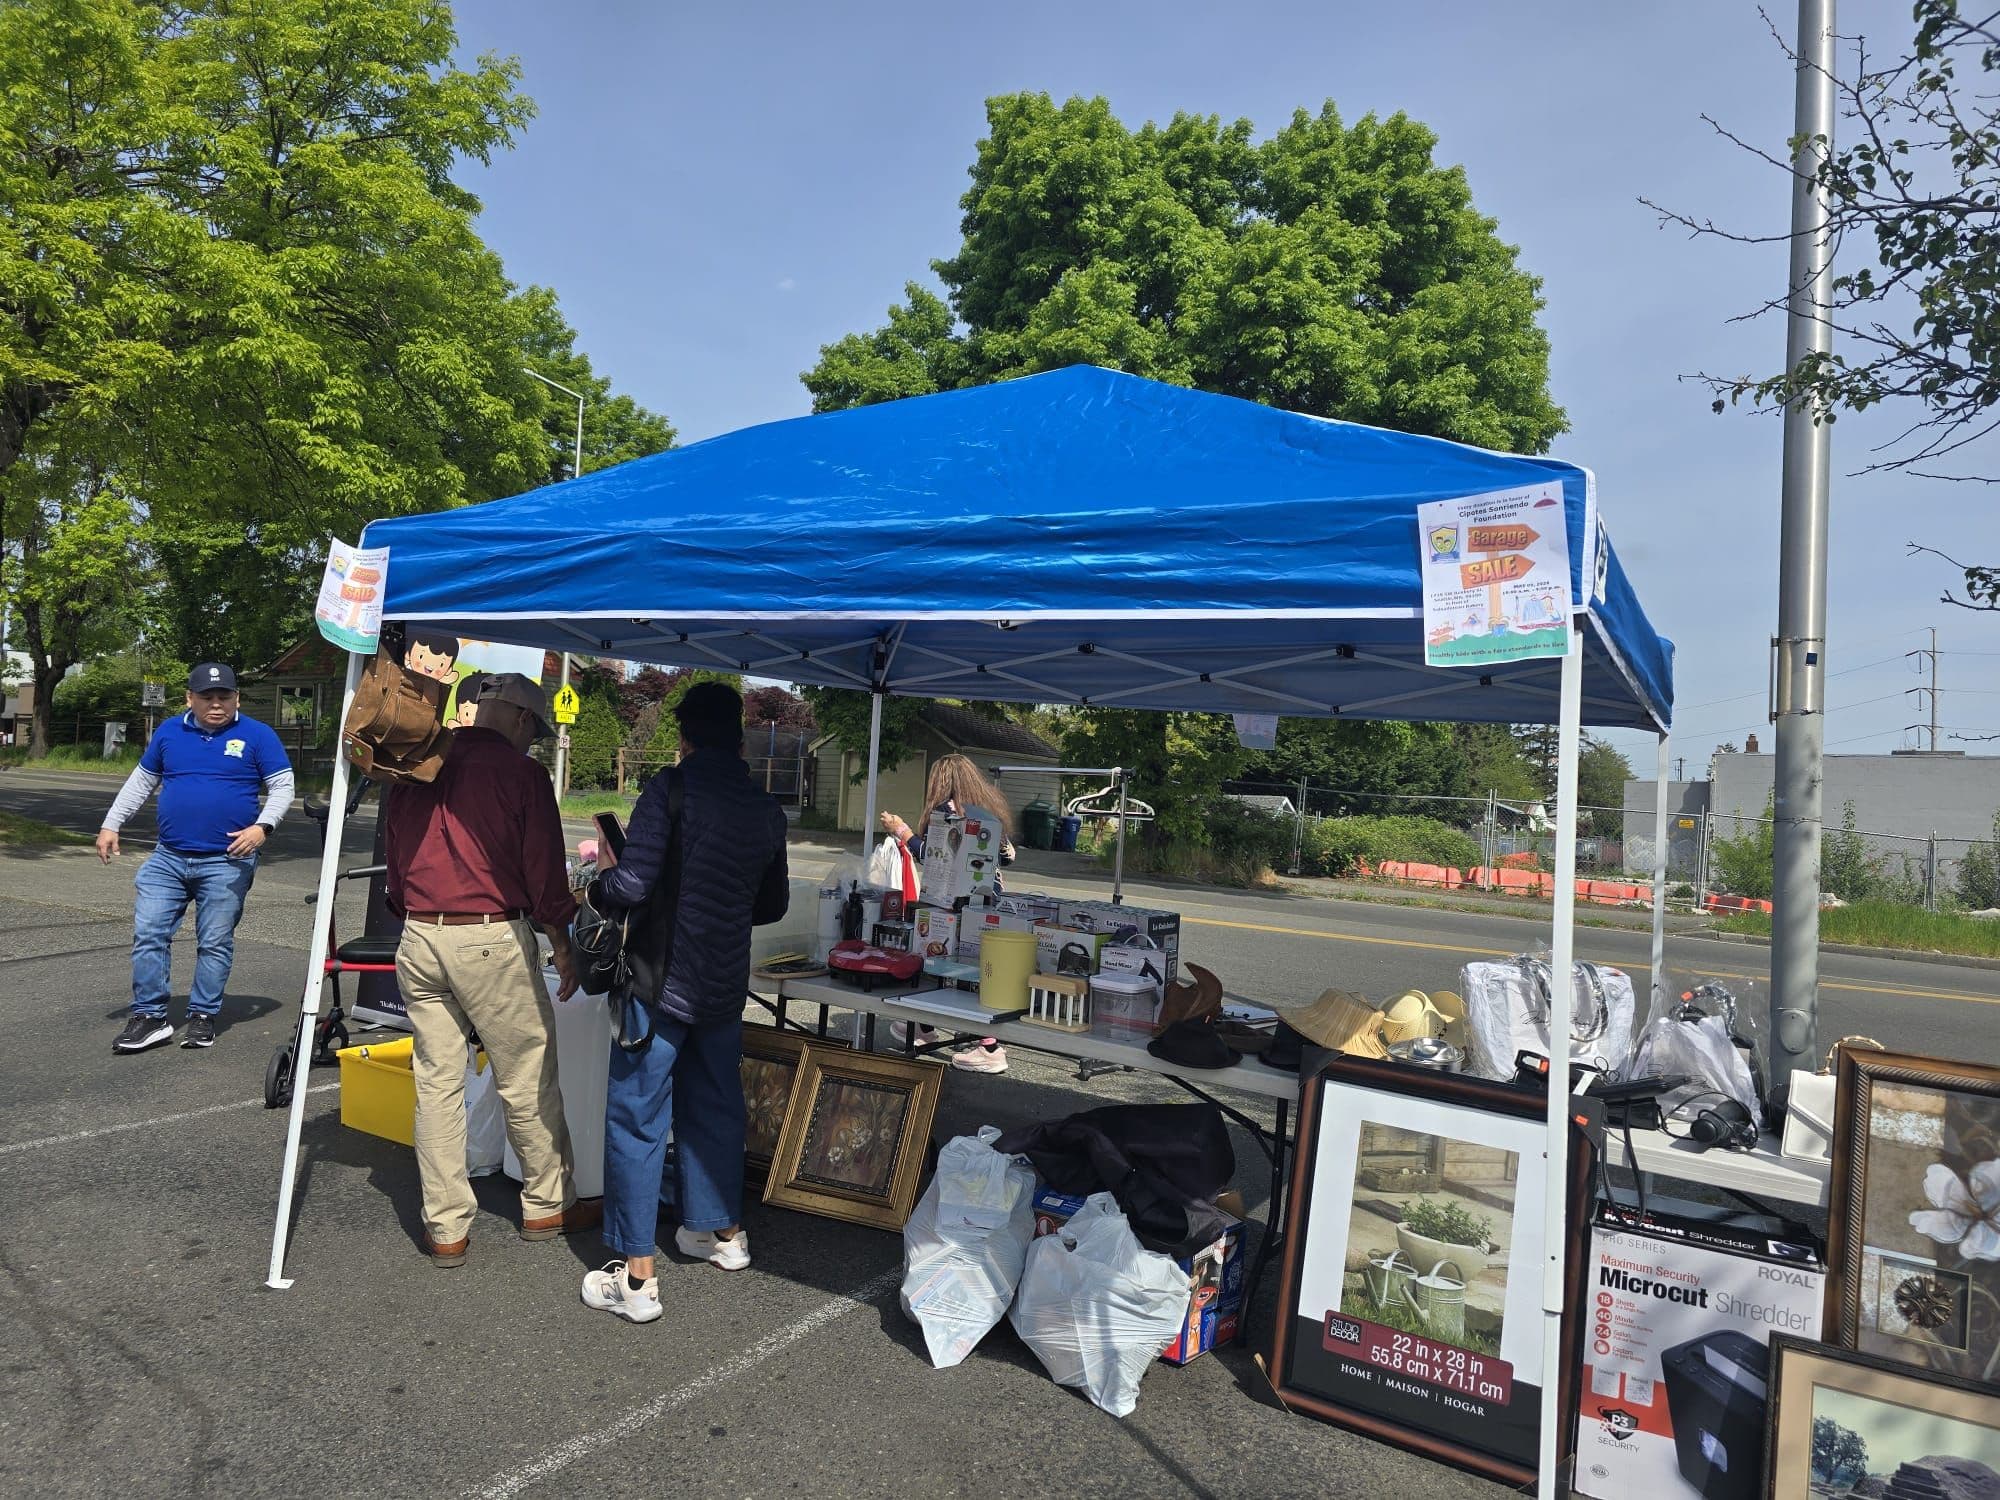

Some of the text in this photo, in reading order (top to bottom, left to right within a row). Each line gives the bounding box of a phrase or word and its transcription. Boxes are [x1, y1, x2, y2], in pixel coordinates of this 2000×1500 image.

[1459, 507, 1487, 518] Cipotes
[1474, 511, 1517, 523] Foundation
[1471, 529, 1528, 547] Garage
[1468, 556, 1519, 584] SALE
[345, 586, 374, 600] SALE
[1602, 1234, 1667, 1255] PRO SERIES
[1688, 1231, 1757, 1250] Shredder
[1601, 1253, 1700, 1286] Maximum Security
[1758, 1265, 1815, 1290] ROYAL
[1600, 1267, 1812, 1332] Microcut Shredder
[1600, 1295, 1610, 1304] 18
[1597, 1311, 1612, 1321] 40
[1332, 1318, 1360, 1334] STUDIO
[1392, 1334, 1484, 1375] 22 in x 28 in
[1371, 1346, 1503, 1400] 55.8 cm x 71.1 cm
[1340, 1363, 1486, 1417] HOME MAISON HOGAR
[1611, 1414, 1629, 1427] P3
[1598, 1436, 1640, 1453] SECURITY
